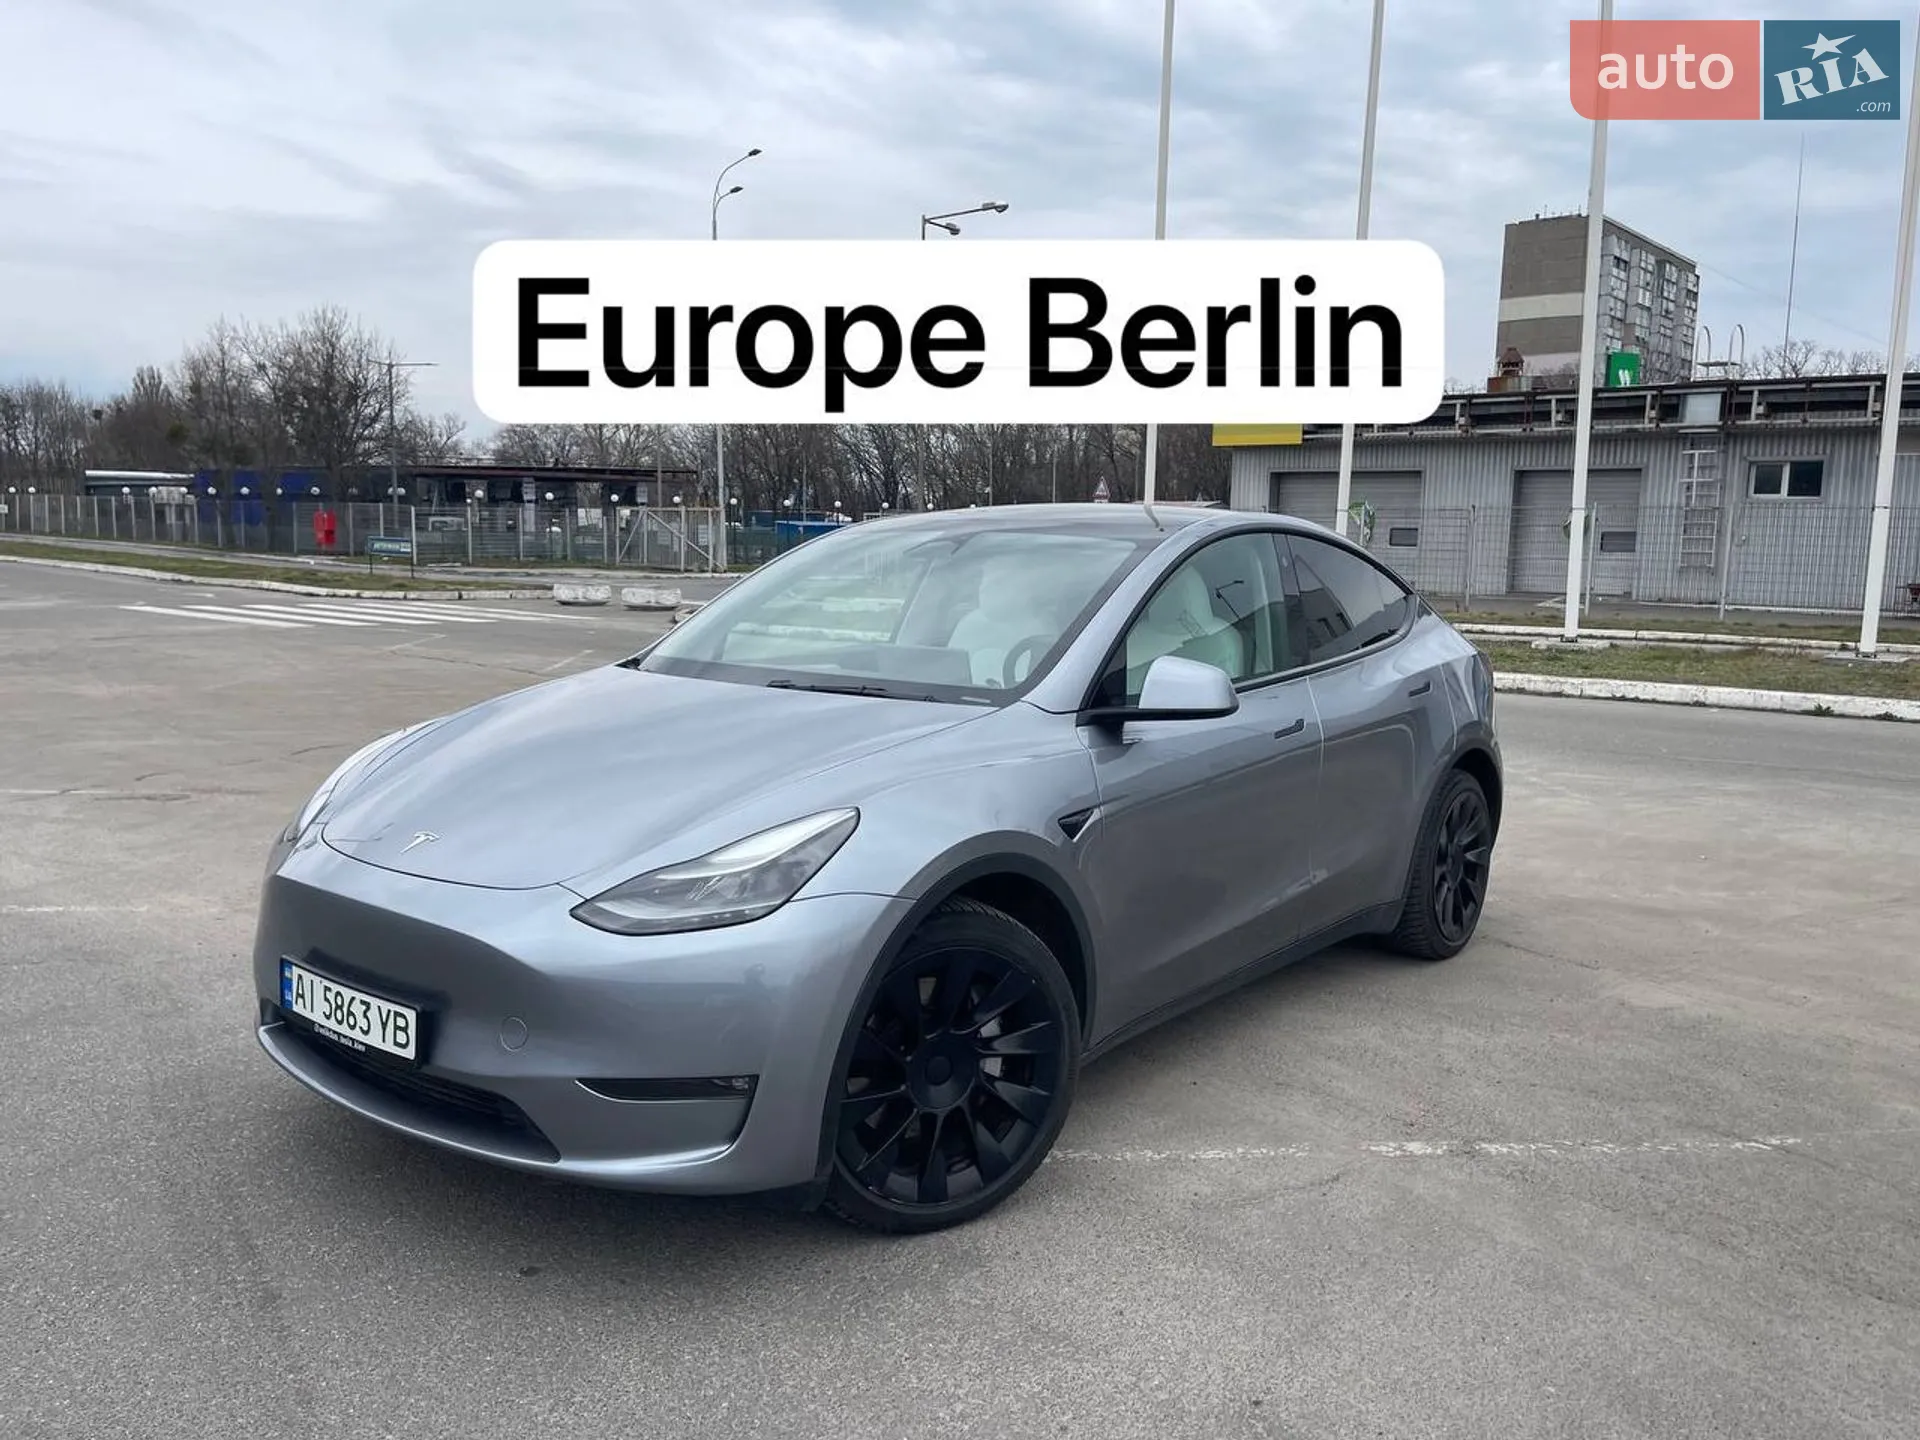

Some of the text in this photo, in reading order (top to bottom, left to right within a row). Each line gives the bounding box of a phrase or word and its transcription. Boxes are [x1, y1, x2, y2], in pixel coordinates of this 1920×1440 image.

[295, 973, 314, 1014] AI
[323, 985, 371, 1036] 5863
[377, 1005, 410, 1050] YB
